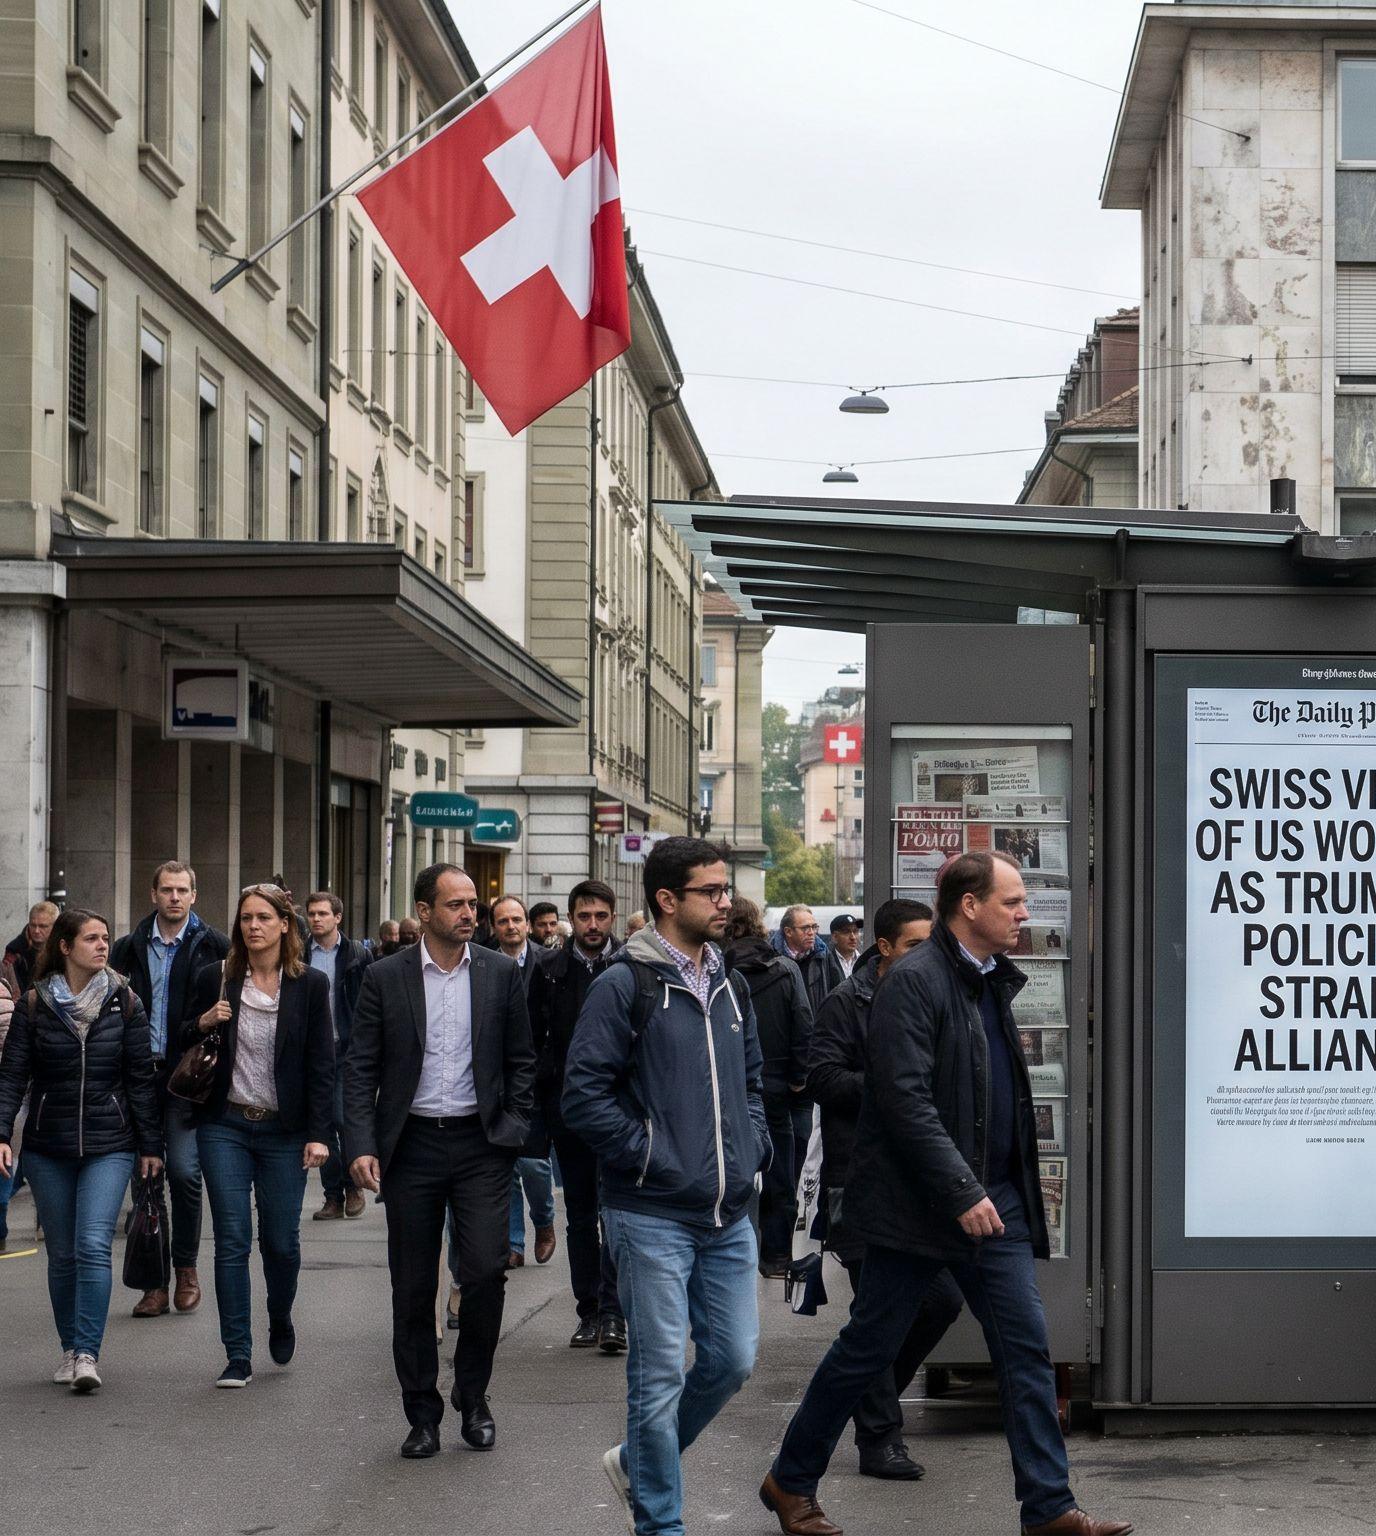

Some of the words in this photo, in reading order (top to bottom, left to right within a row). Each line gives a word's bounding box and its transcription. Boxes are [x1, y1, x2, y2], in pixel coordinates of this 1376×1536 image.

[1252, 700, 1291, 727] The
[1296, 700, 1354, 729] Daily
[1209, 767, 1332, 810] SWISS
[1195, 819, 1245, 862] OF
[1254, 819, 1305, 862] US
[1210, 870, 1266, 915] AS
